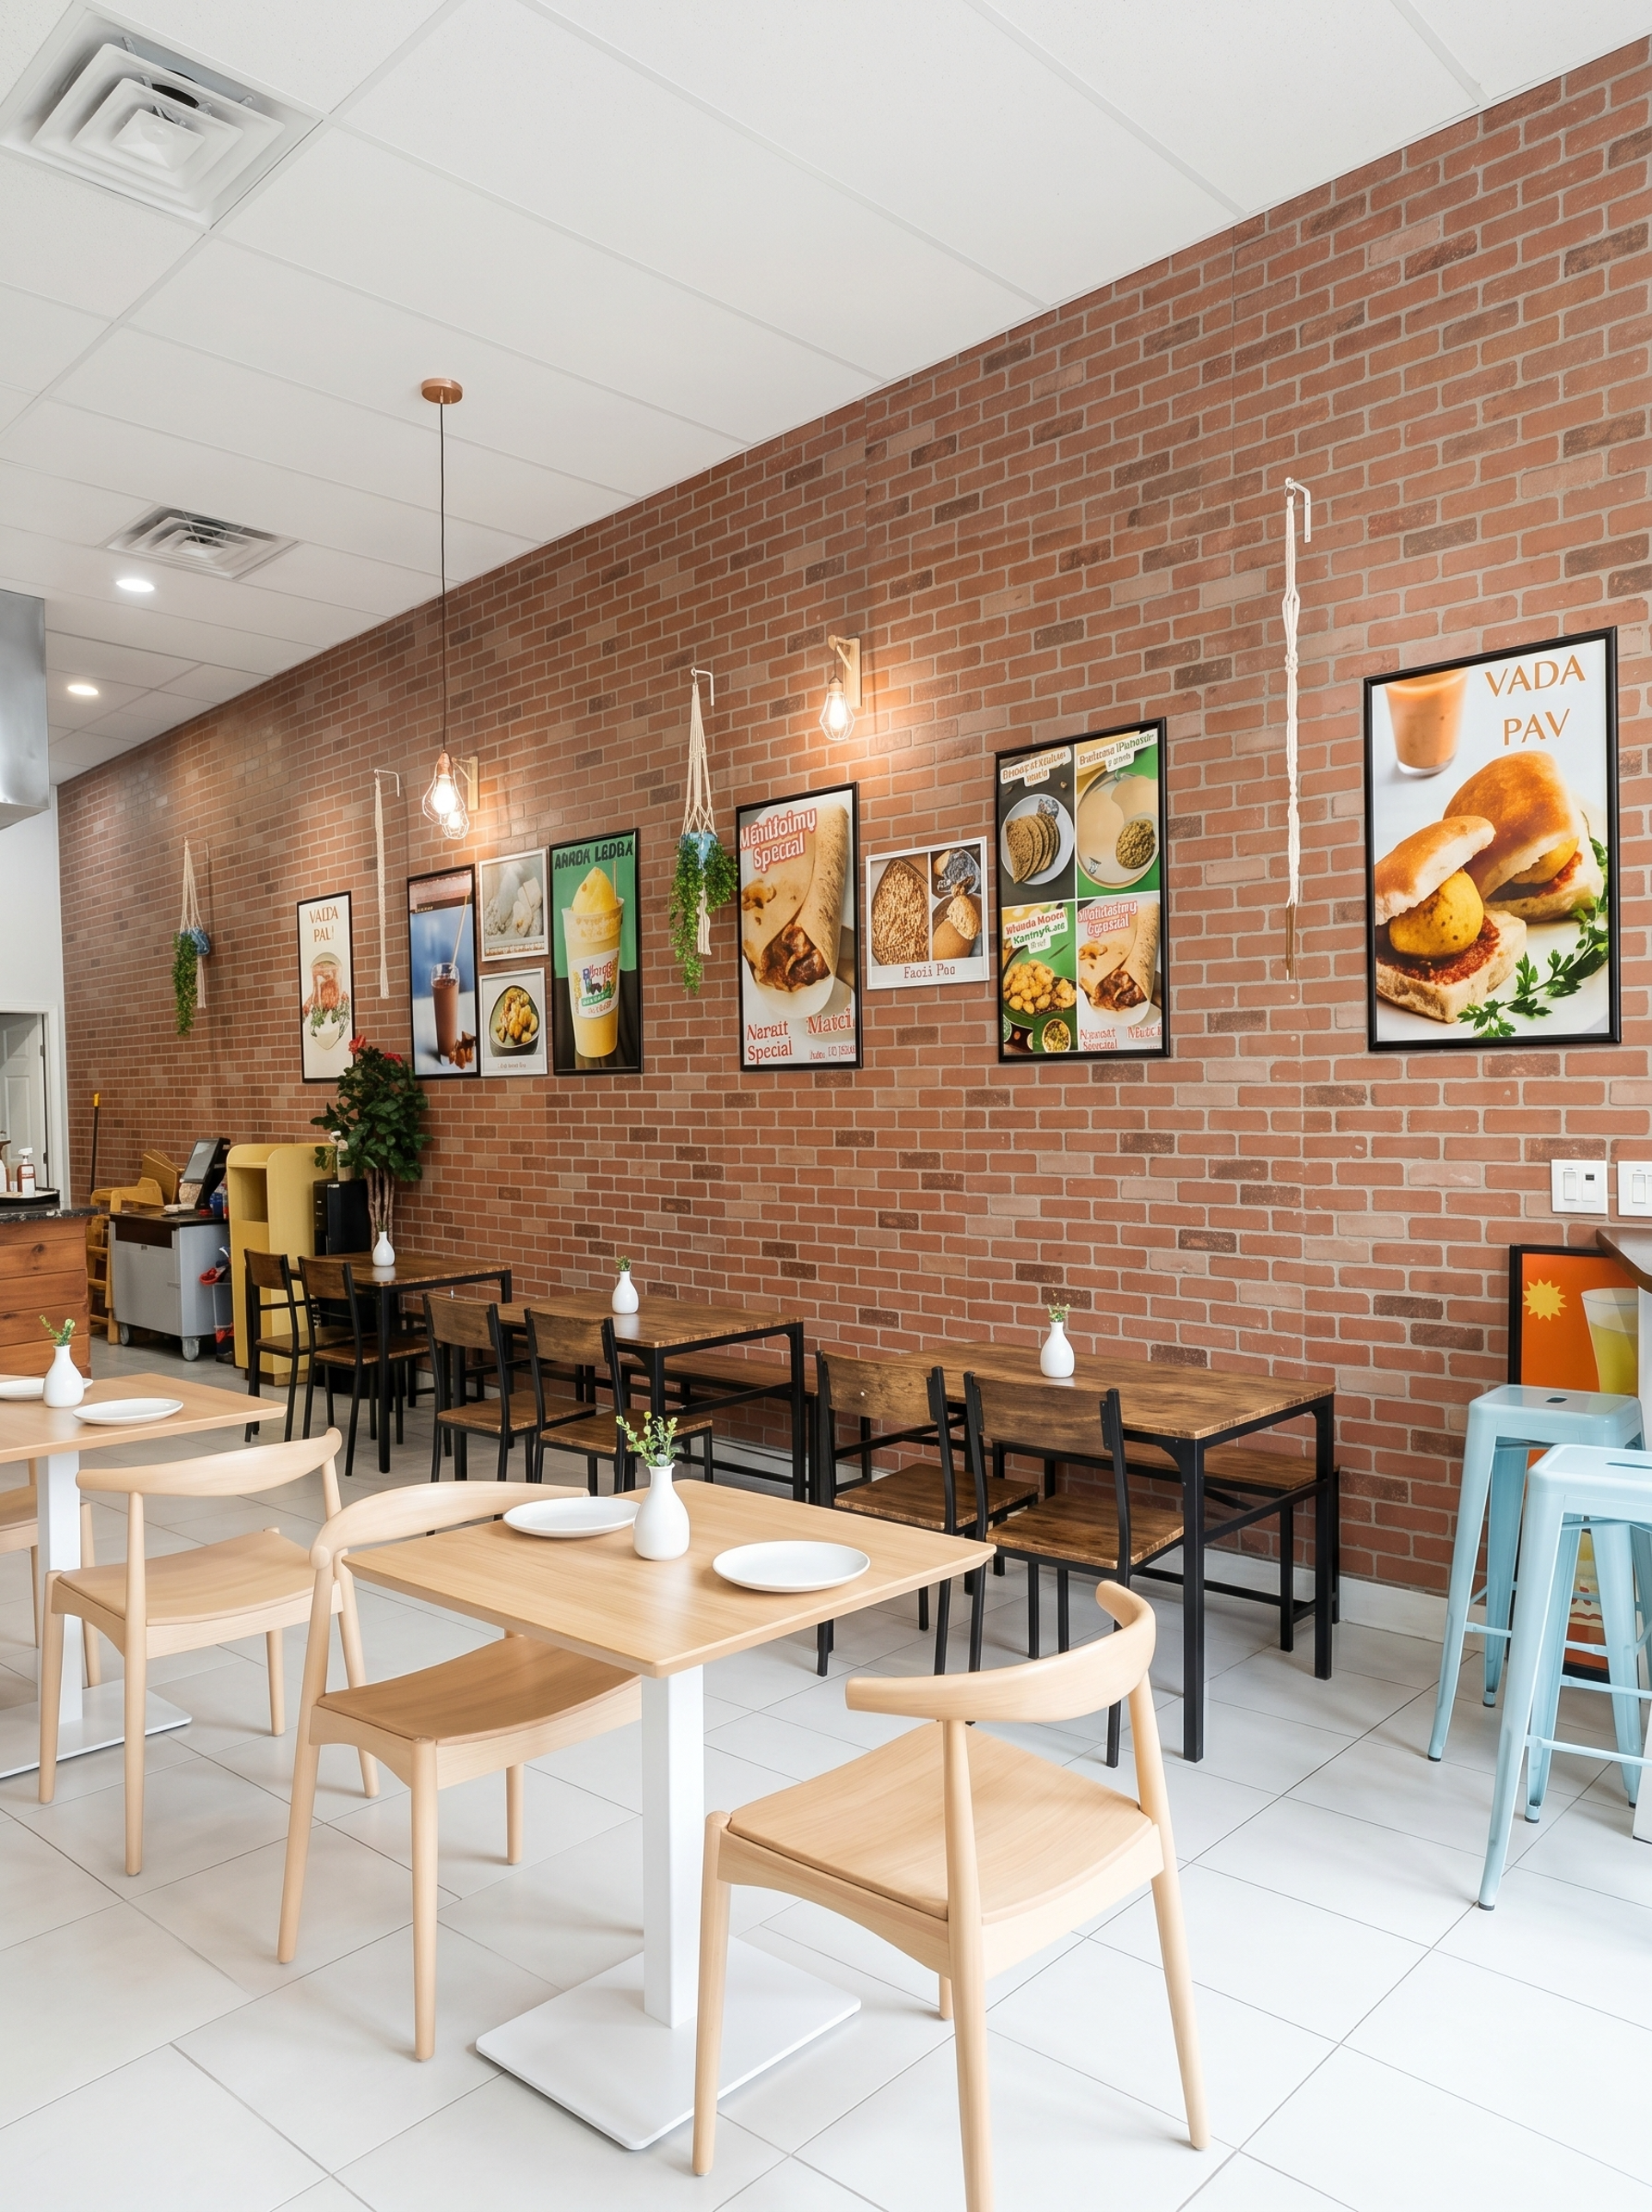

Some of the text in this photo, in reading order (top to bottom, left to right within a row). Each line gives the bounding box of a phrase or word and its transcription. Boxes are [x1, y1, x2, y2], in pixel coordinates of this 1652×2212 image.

[1484, 654, 1586, 698] VADA
[1503, 708, 1571, 747] PAV
[748, 1037, 793, 1064] Special
